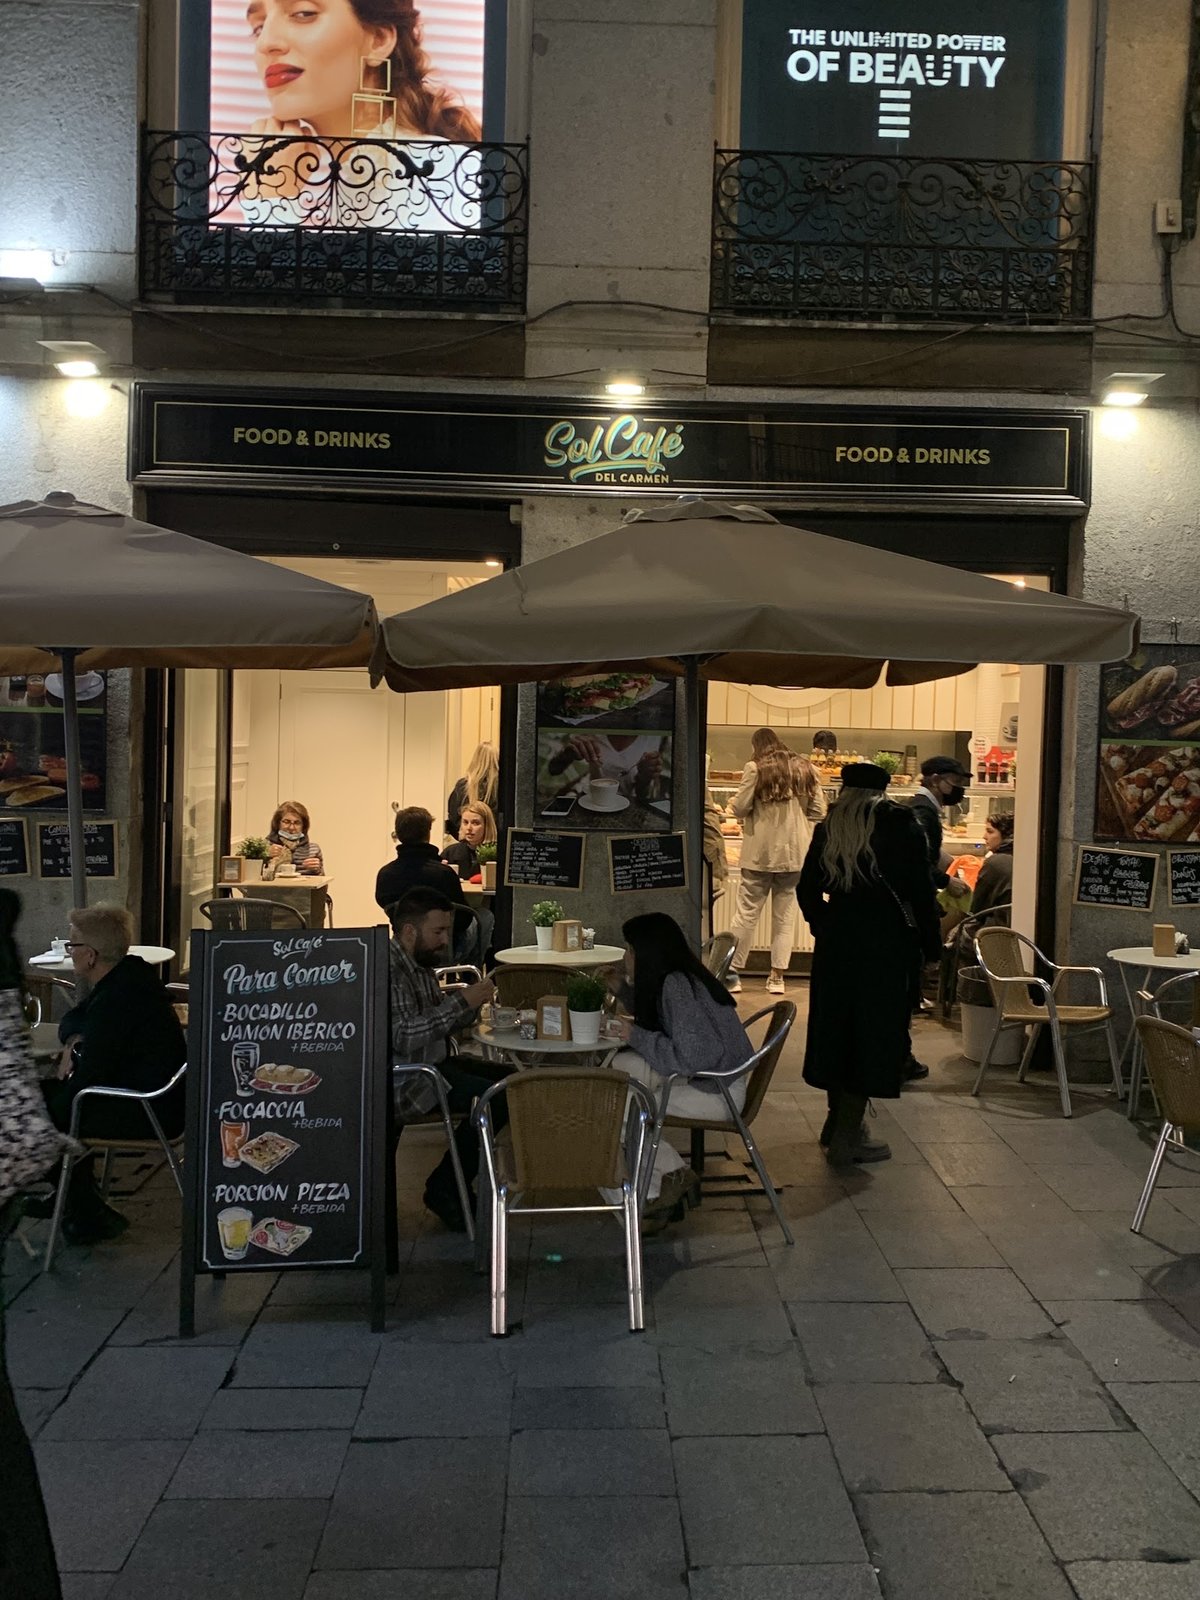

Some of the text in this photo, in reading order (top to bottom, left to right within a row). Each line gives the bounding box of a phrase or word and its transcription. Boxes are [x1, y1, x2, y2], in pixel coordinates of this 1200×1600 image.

[789, 29, 1006, 51] THE UNLIMITED POWER
[787, 50, 1006, 88] OF BEAUTY
[233, 427, 391, 449] FOOD & DRINKS
[544, 414, 684, 473] Sol Café
[835, 446, 991, 465] FOOD & DRINKS
[595, 473, 669, 484] DEL CARMEN
[273, 935, 323, 958] Sol Café
[223, 959, 357, 994] Para Comer
[223, 1002, 318, 1022] BOCADILLO
[287, 1020, 356, 1040] IBÉRICO
[219, 1100, 305, 1120] FOCACCIA
[297, 1182, 350, 1201] PIZZA
